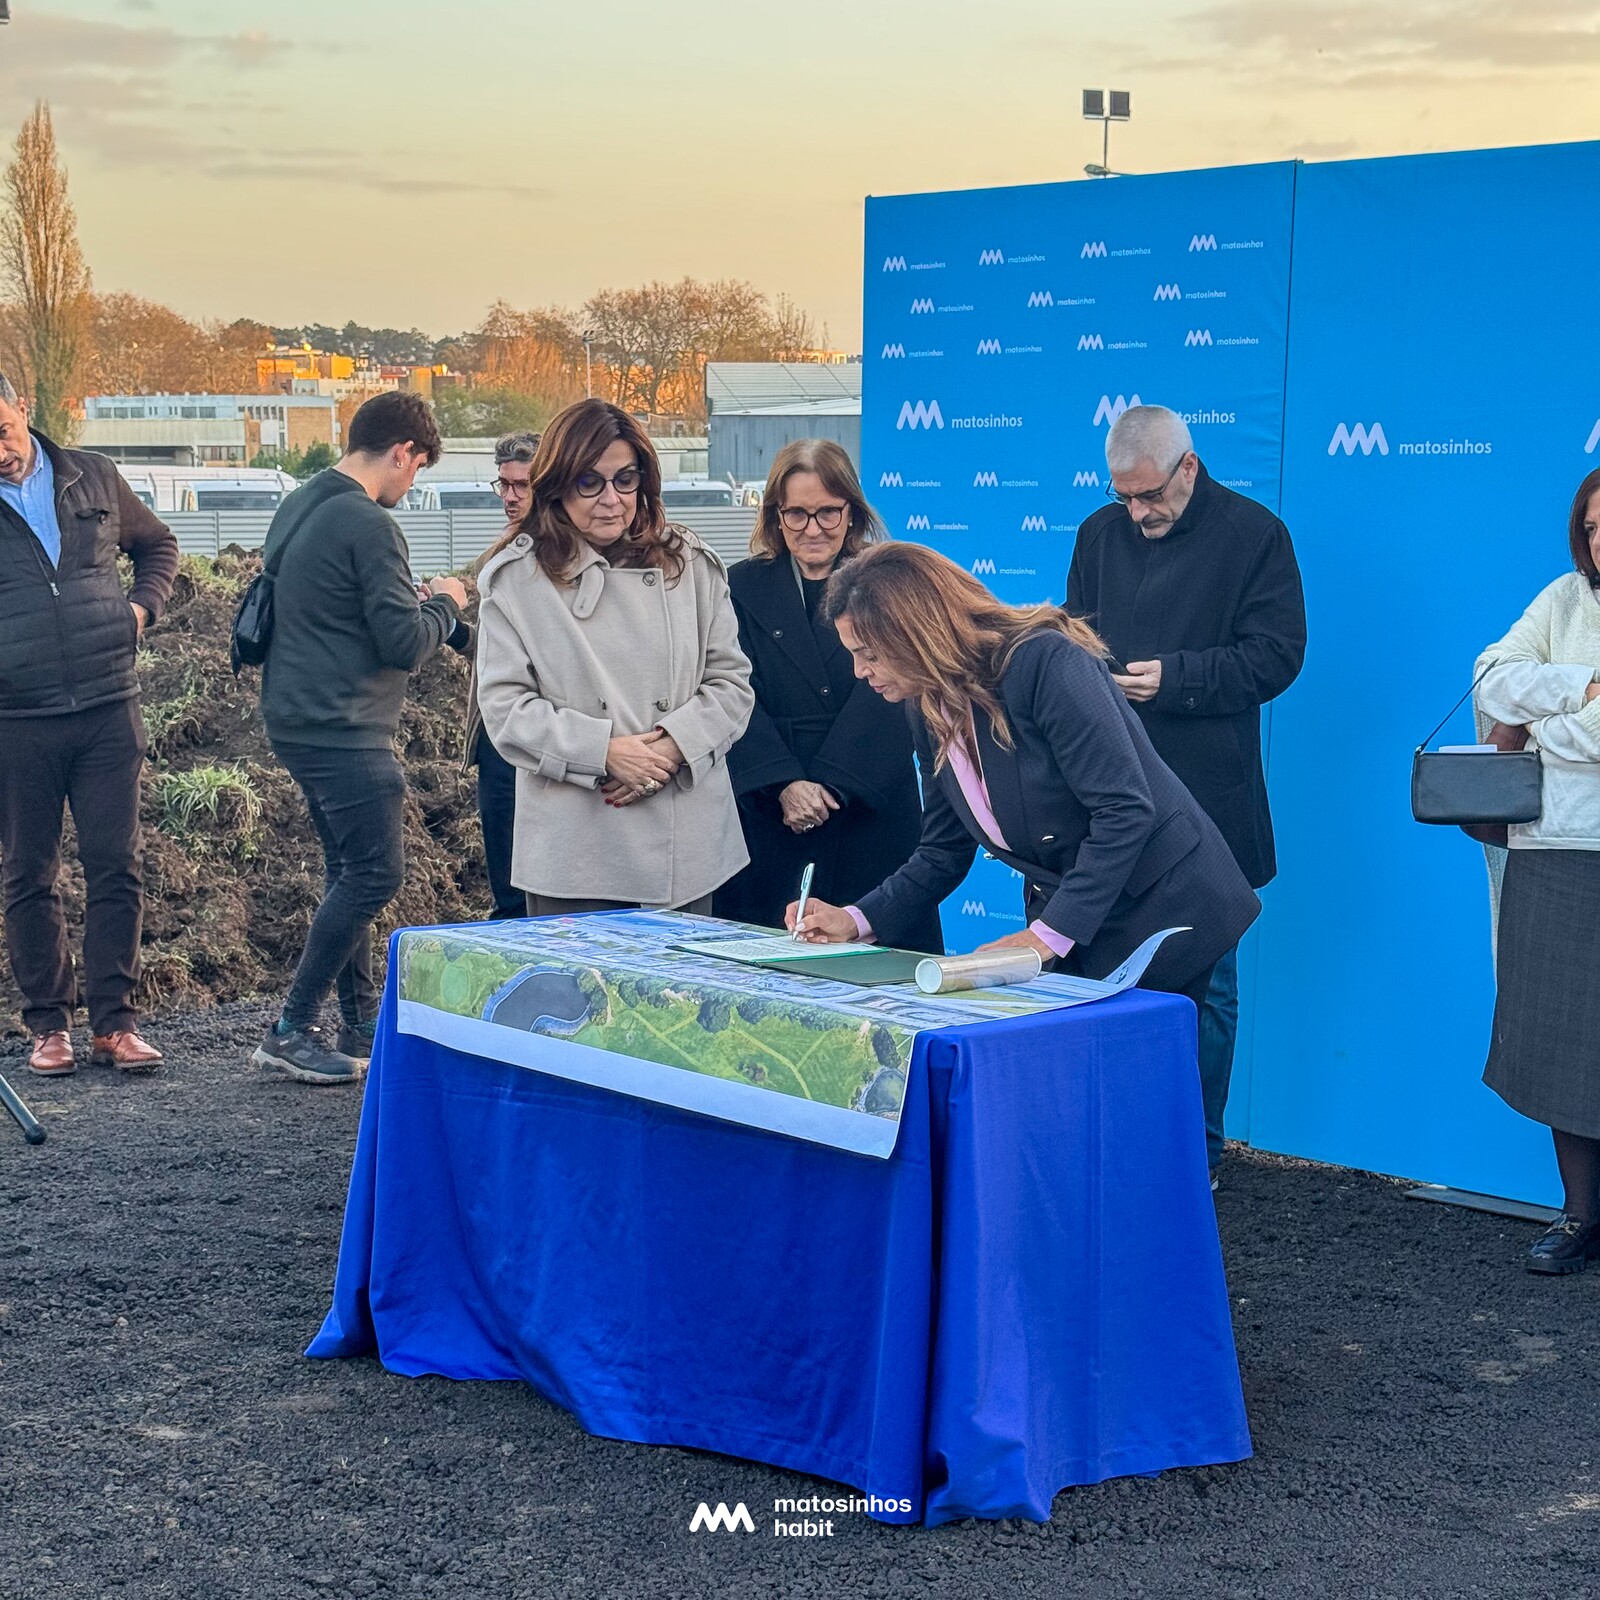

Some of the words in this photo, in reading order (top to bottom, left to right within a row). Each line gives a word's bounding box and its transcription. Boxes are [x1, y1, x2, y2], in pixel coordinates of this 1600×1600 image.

[1221, 239, 1264, 250] matosinhos
[1111, 246, 1151, 257] matosinhos
[1008, 253, 1046, 264] matosinhos
[910, 260, 946, 270] matosinhos
[1185, 289, 1227, 300] matosinhos
[1057, 296, 1096, 306] matosinhos
[938, 303, 974, 313] matosinhos
[1107, 339, 1148, 350] matosinhos
[1217, 335, 1260, 346] matosinhos
[908, 348, 944, 358] matosinhos
[1005, 344, 1043, 354] matosinhos
[951, 413, 1023, 429] matosinhos
[1178, 408, 1236, 424] tosinhos
[1399, 439, 1492, 455] matosinhos
[906, 479, 942, 488] matosinhos
[1001, 479, 1039, 488] matosinhos
[933, 522, 969, 531] matosinhos
[999, 566, 1037, 576] matosinhos
